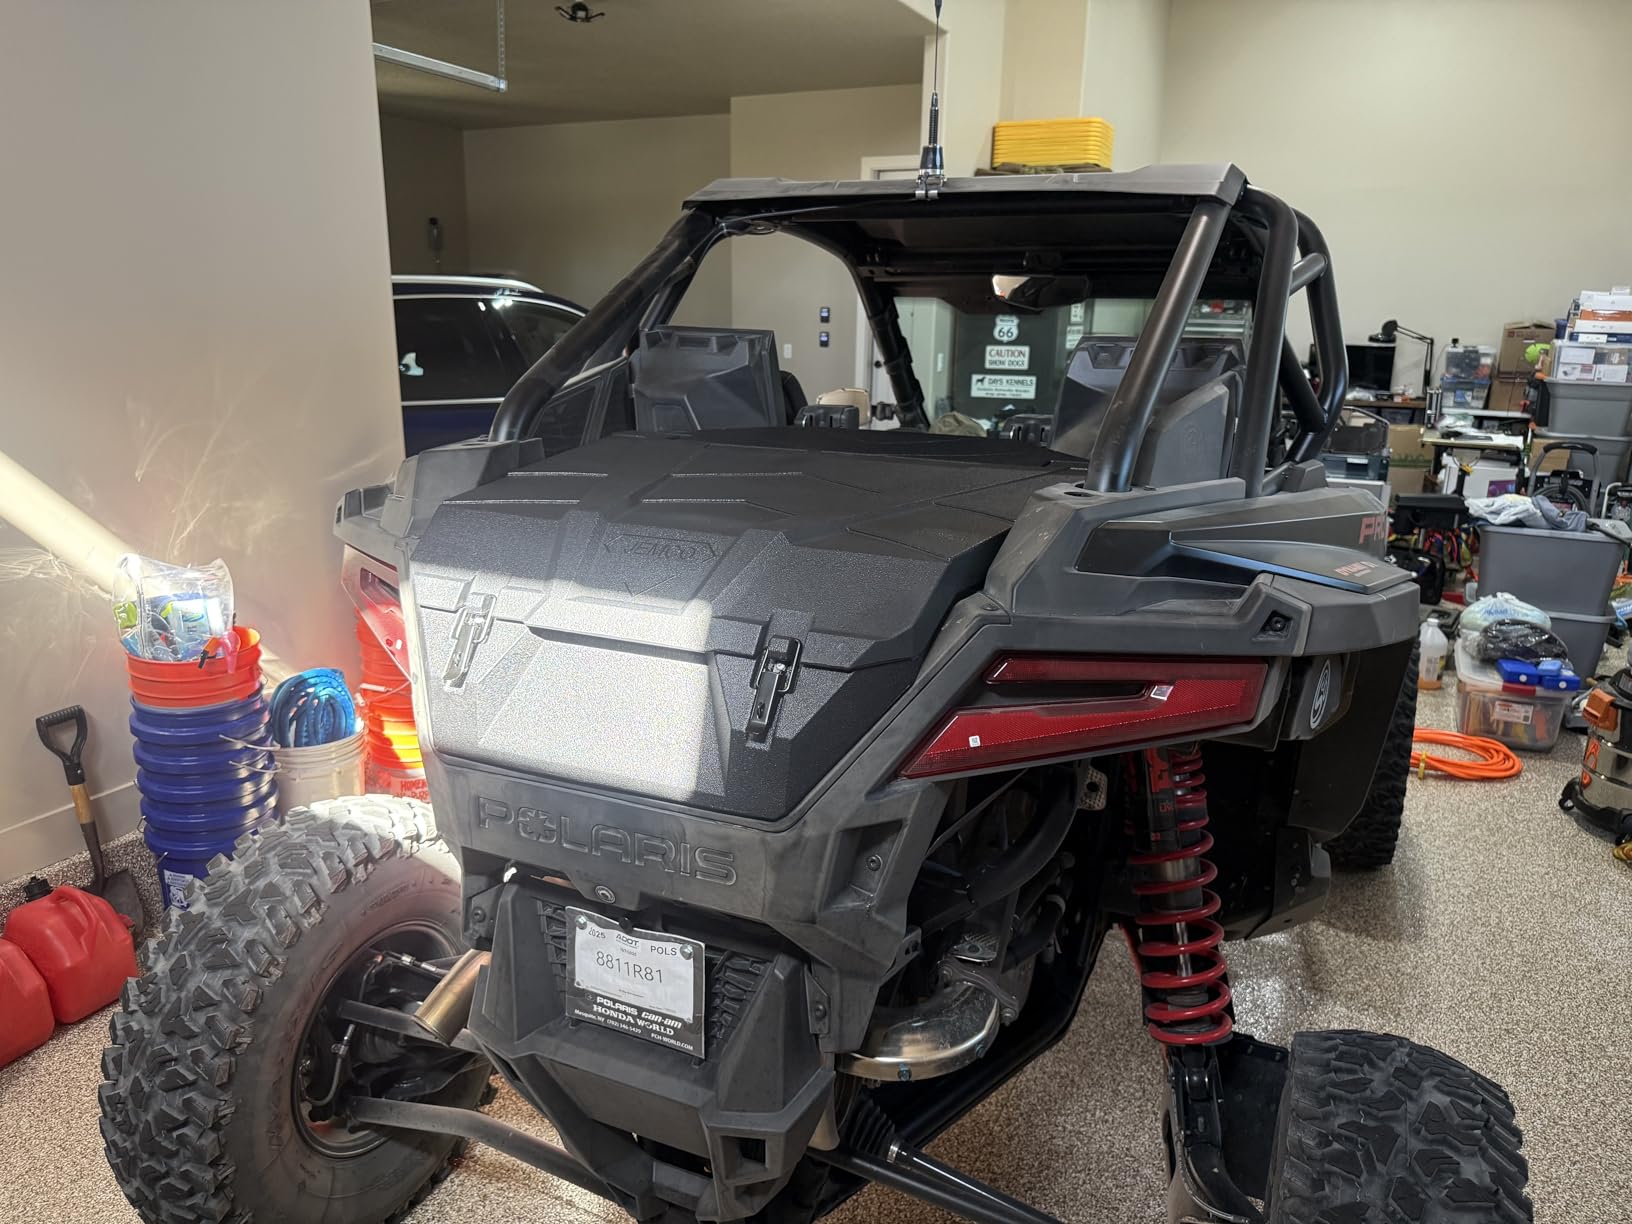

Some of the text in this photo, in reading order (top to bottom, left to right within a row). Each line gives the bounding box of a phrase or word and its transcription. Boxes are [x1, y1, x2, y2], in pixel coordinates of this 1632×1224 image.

[998, 327, 1014, 339] 66
[989, 349, 1026, 359] CAUTION
[1008, 359, 1025, 367] DOGS
[1006, 378, 1034, 387] KENNELS
[478, 796, 737, 886] POLARIS
[588, 927, 606, 939] 2025
[616, 934, 640, 946] ADOT
[650, 945, 677, 956] POLS
[596, 950, 662, 983] 8811R81
[596, 996, 638, 1016] POLARIS
[593, 1004, 635, 1024] HONDA
[636, 1019, 674, 1036] WORLD
